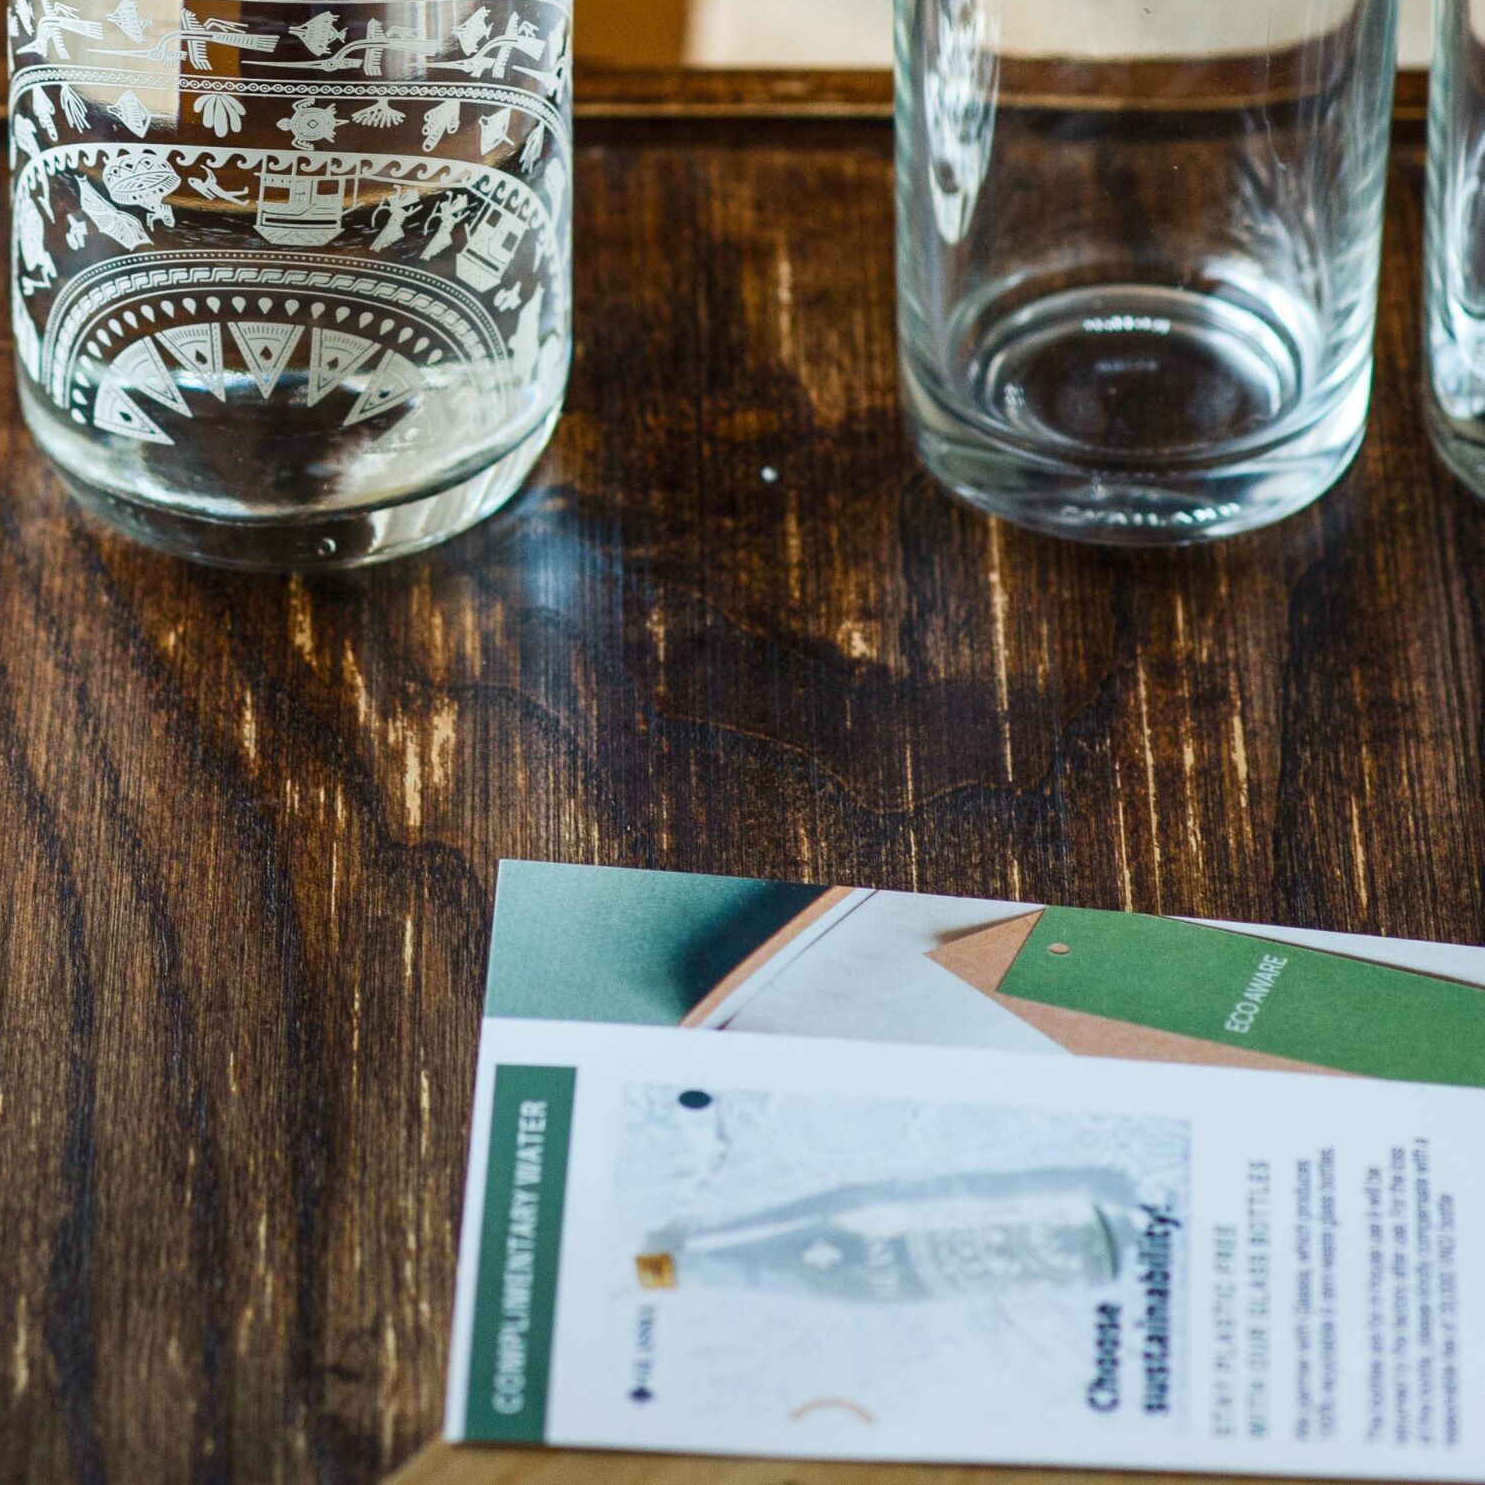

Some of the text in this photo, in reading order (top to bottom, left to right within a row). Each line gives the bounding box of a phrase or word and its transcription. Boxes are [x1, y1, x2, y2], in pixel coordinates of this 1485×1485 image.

[1224, 955, 1288, 1033] ECO AWARE
[1247, 1161, 1269, 1246] BOTTLES
[492, 1100, 547, 1414] COMPLIMENTARY WATER
[1213, 1224, 1236, 1274] FREE
[1249, 1254, 1269, 1318] GLASS
[1135, 1204, 1181, 1413] sustainability!
[1213, 1283, 1235, 1372] PLASTIC
[1087, 1303, 1120, 1413] Choose
